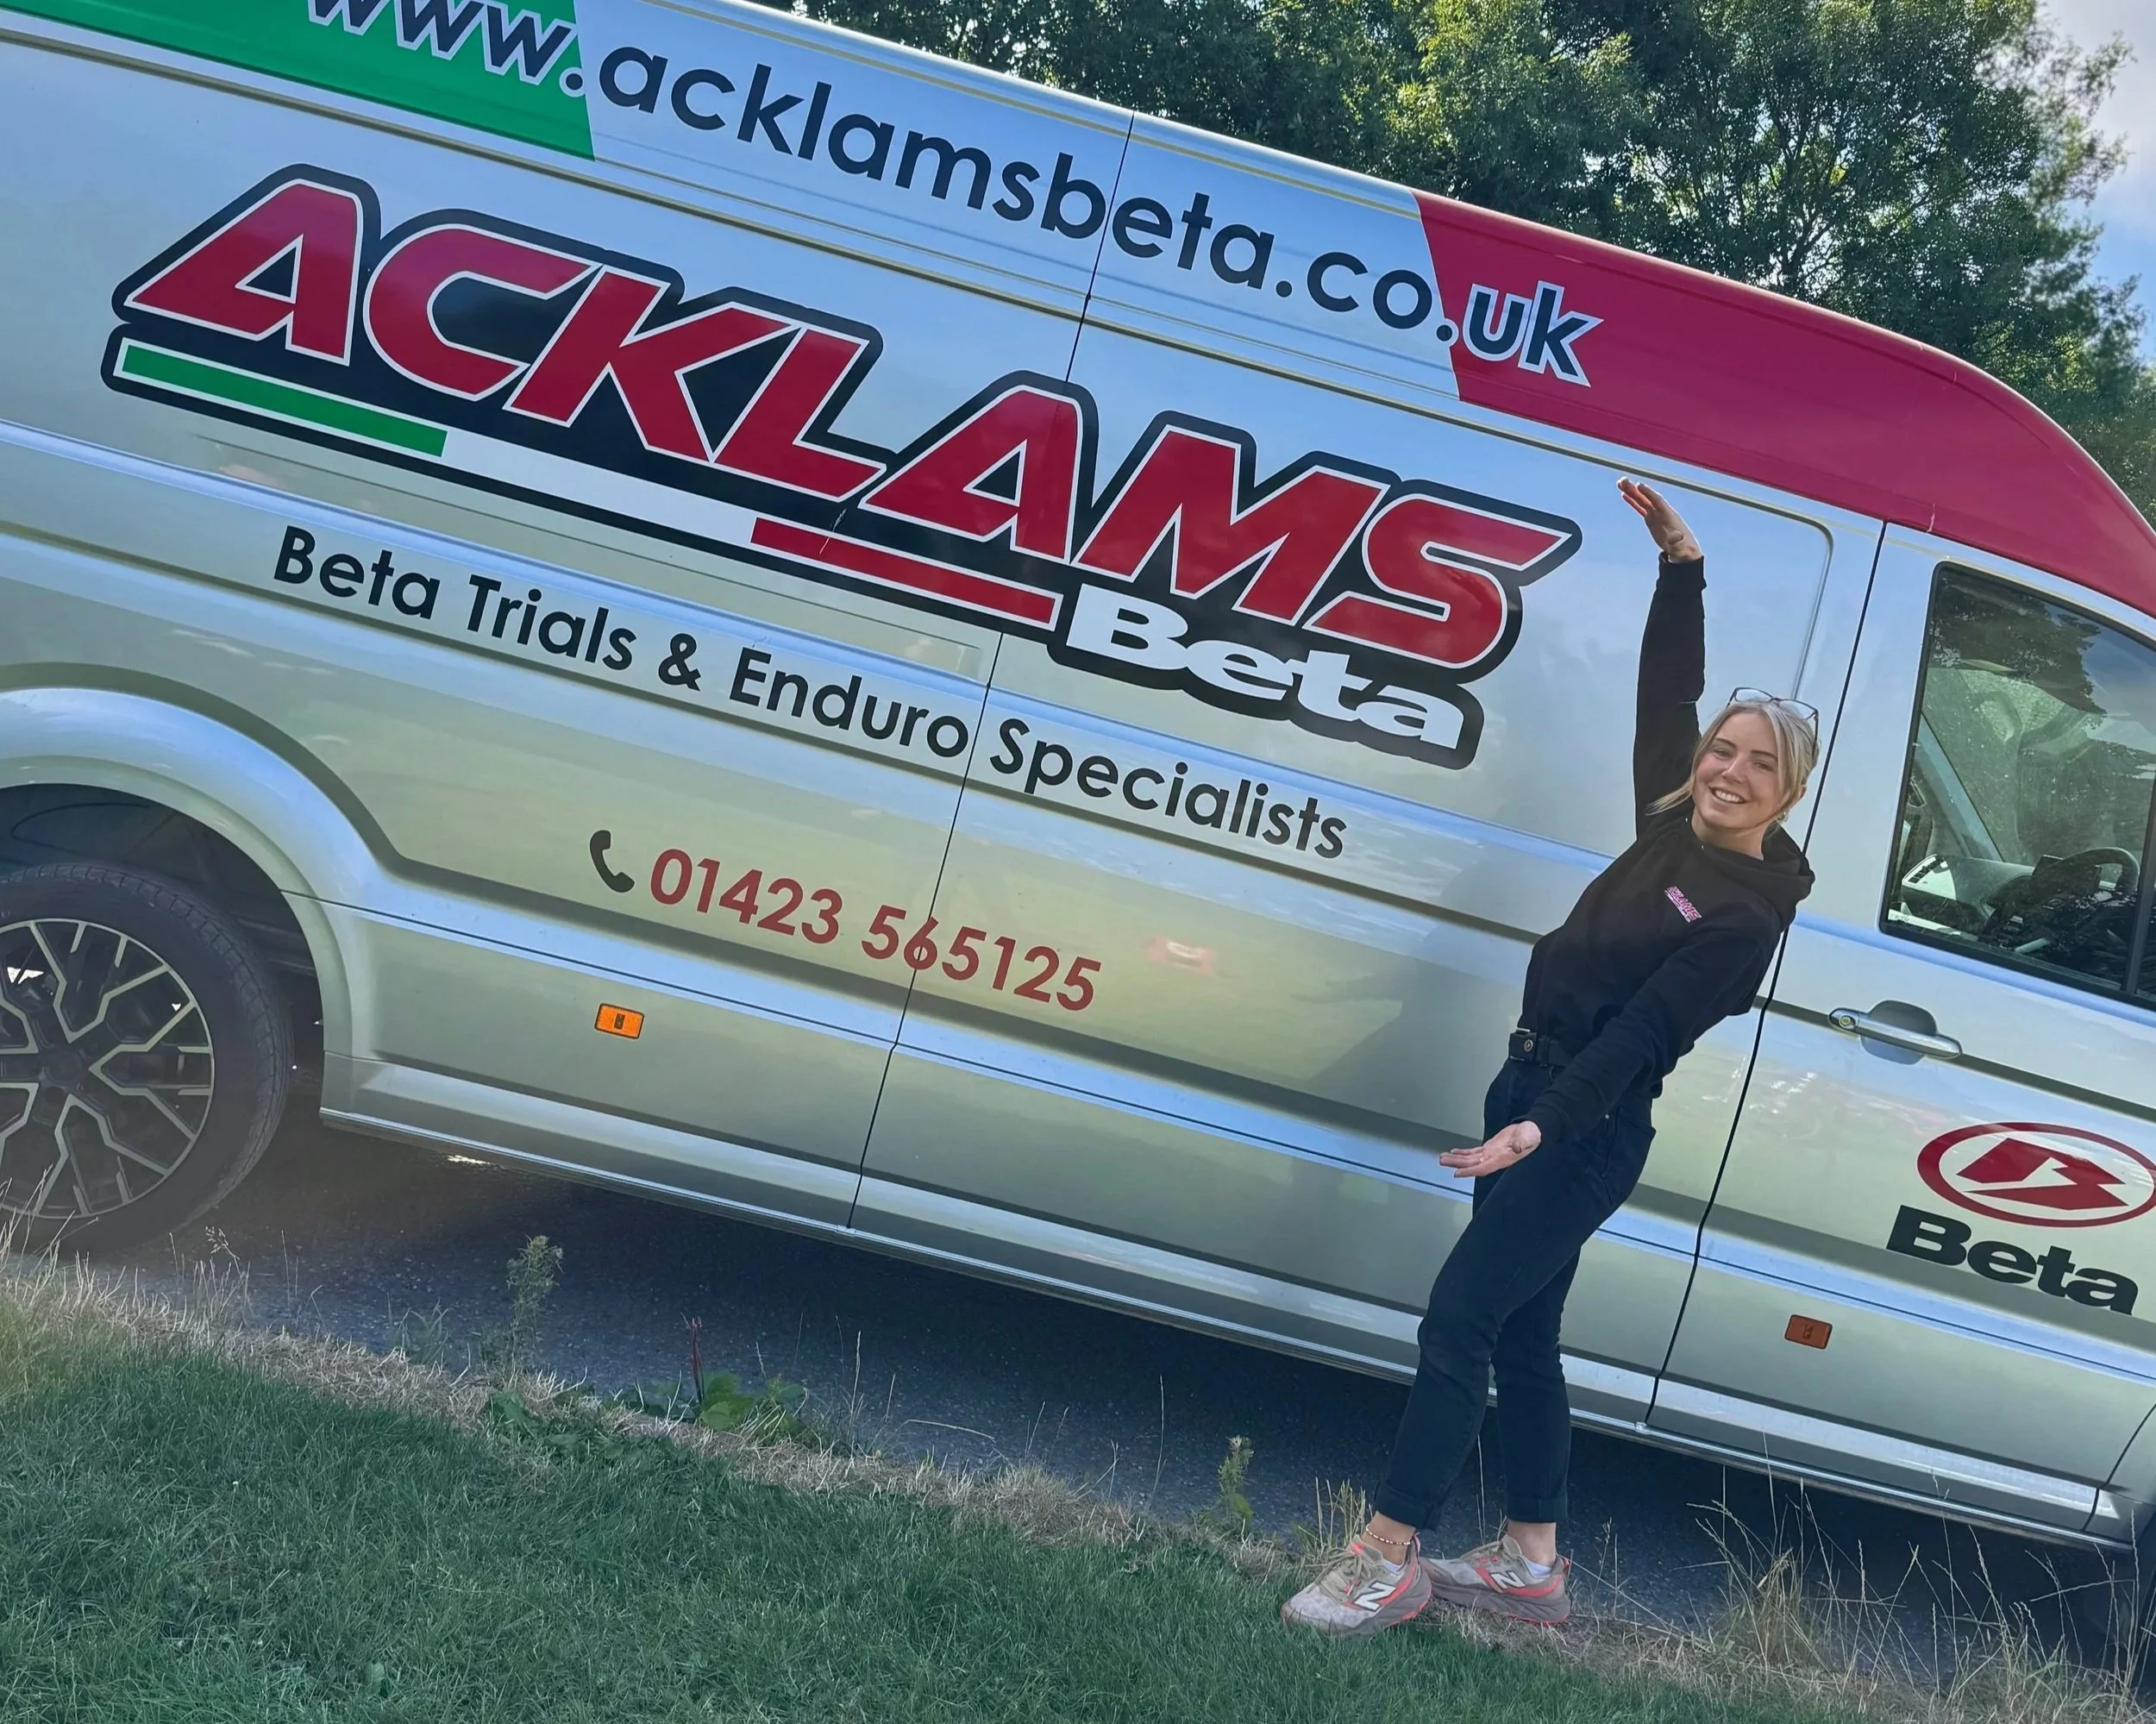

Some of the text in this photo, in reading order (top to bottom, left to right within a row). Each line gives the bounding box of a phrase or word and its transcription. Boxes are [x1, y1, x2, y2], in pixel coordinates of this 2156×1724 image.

[125, 179, 1570, 668] ACKLAMS
[273, 525, 1347, 859] Beta Trials & Enduro Specialists
[1066, 584, 1464, 749] Beta
[649, 849, 1101, 1011] 01423 565125
[1886, 1205, 2139, 1315] Beta
